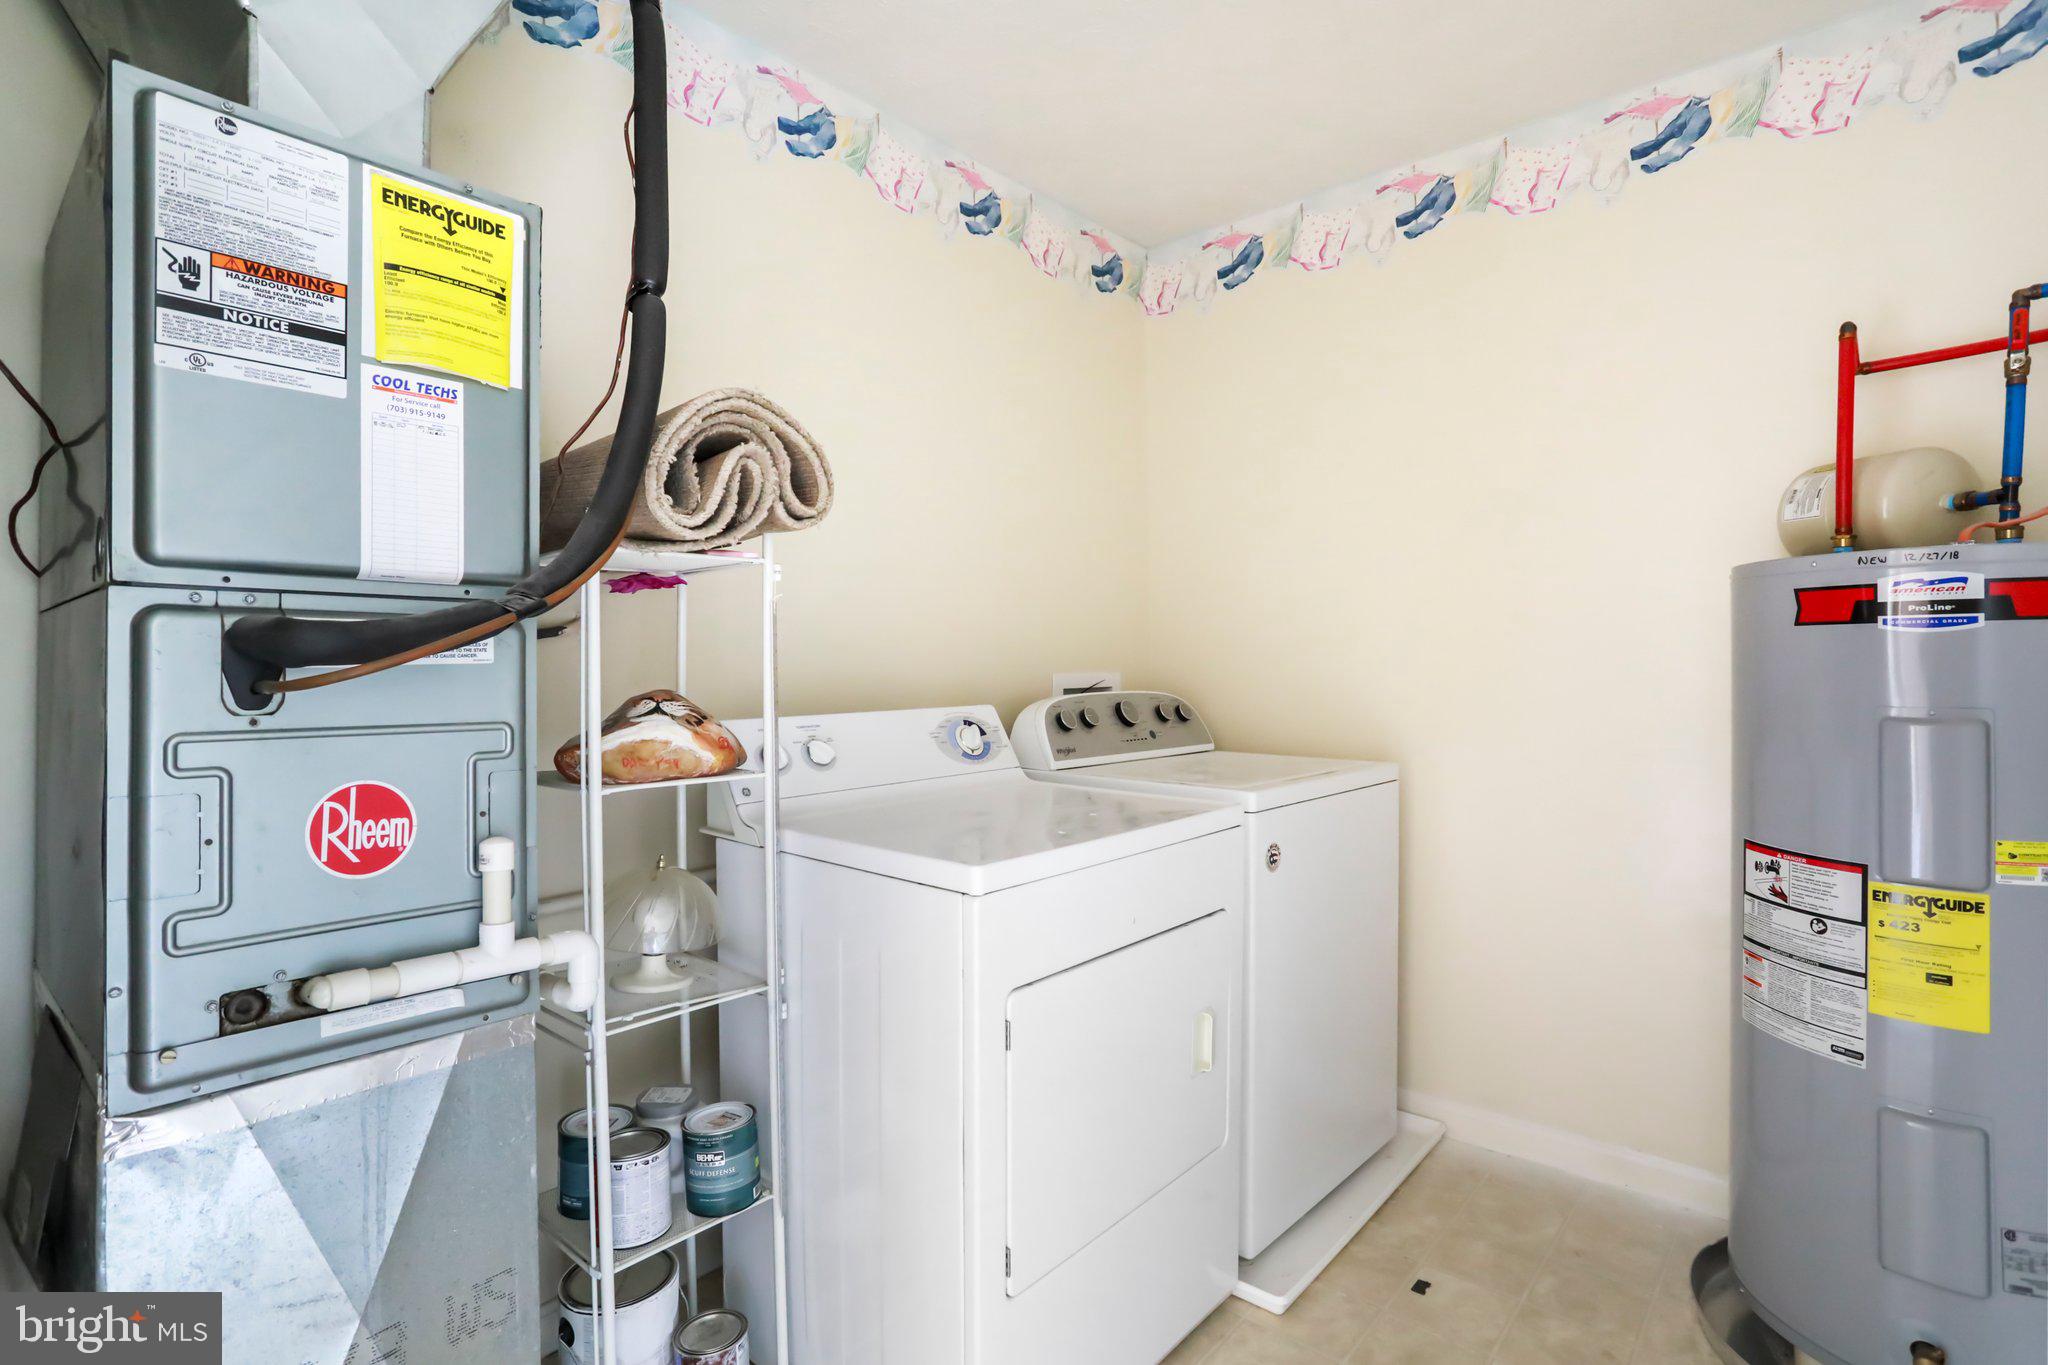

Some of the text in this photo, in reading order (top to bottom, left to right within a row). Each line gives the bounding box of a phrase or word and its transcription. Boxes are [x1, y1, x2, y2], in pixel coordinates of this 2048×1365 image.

[382, 187, 506, 240] ENERGYGUIDE
[243, 260, 335, 294] WARNING
[225, 271, 334, 303] HAZARDOUS VOLTAGE
[251, 286, 270, 294] CAUSE
[272, 291, 292, 299] SEVERE
[294, 296, 323, 307] PERSONAL
[223, 308, 289, 333] NOTICE
[372, 375, 458, 399] COOL TECHS
[386, 403, 446, 420] (703) 915-9149
[404, 398, 429, 407] Service
[1857, 551, 1960, 565] NEW 12/27/18
[1891, 585, 1966, 593] american
[321, 787, 409, 862] Rheem
[1889, 920, 1921, 933] 423
[696, 1153, 715, 1162] BEHR
[707, 1166, 736, 1177] DEFENSE
